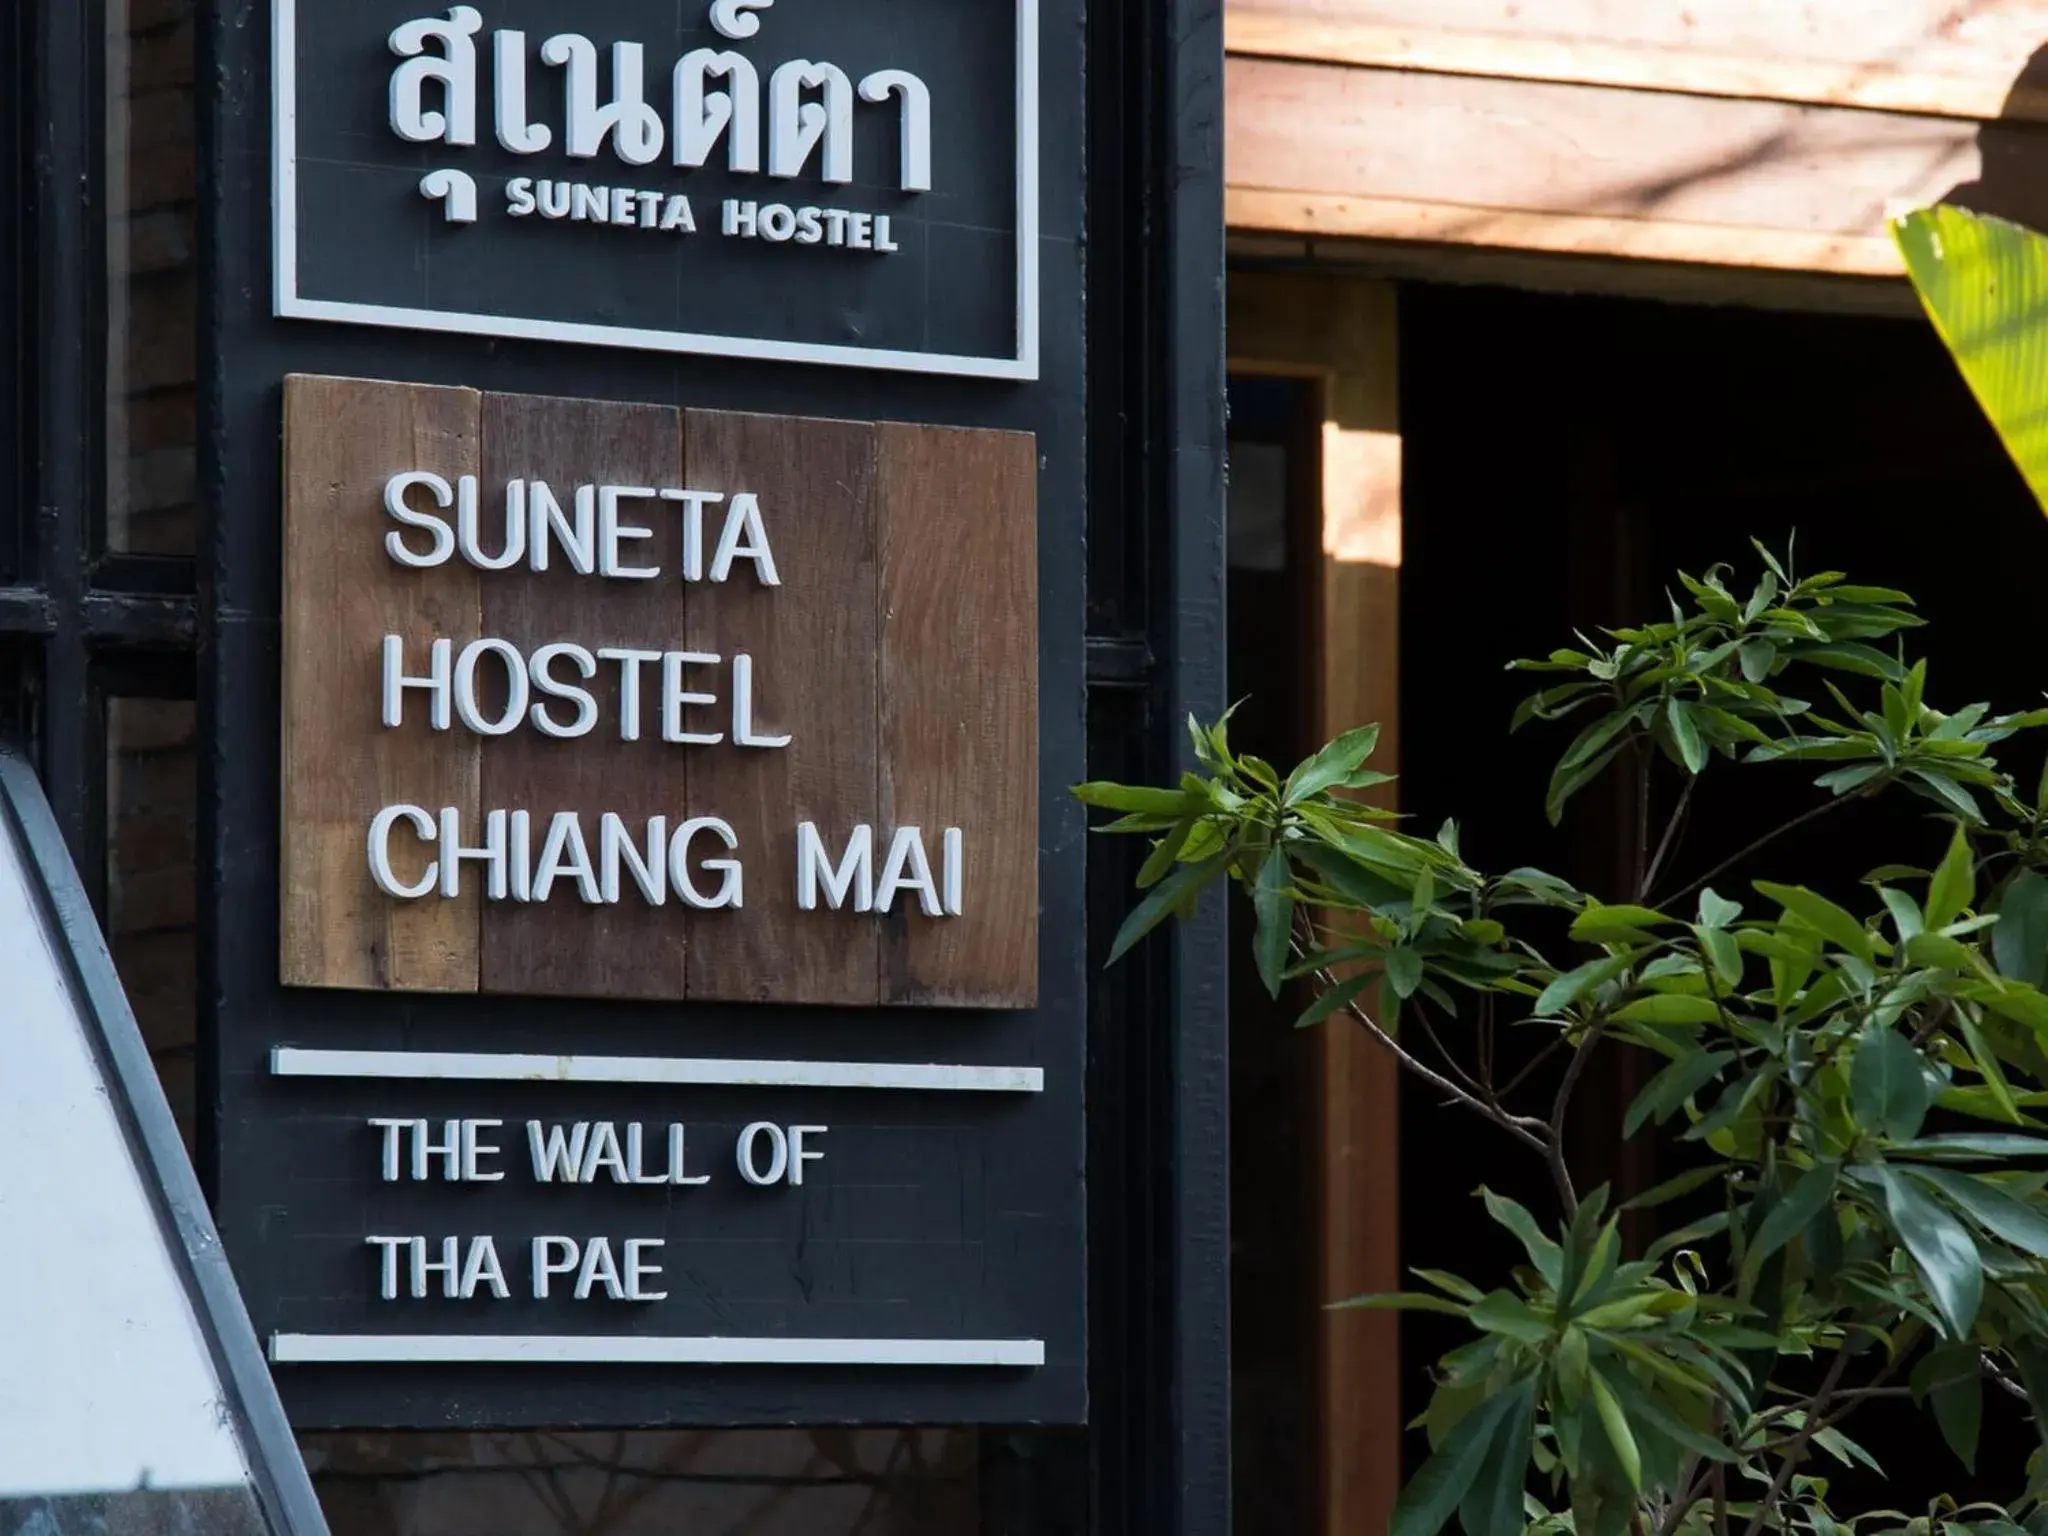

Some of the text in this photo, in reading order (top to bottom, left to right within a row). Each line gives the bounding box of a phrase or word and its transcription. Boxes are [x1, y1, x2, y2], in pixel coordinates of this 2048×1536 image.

[505, 177, 899, 252] SUNETA HOSTEL
[384, 471, 782, 586] SUNETA
[383, 634, 793, 748] HOSTEL
[367, 805, 963, 917] CHIANG MAI
[367, 1117, 829, 1186] THE WALL OF
[365, 1234, 668, 1301] THA PAE
